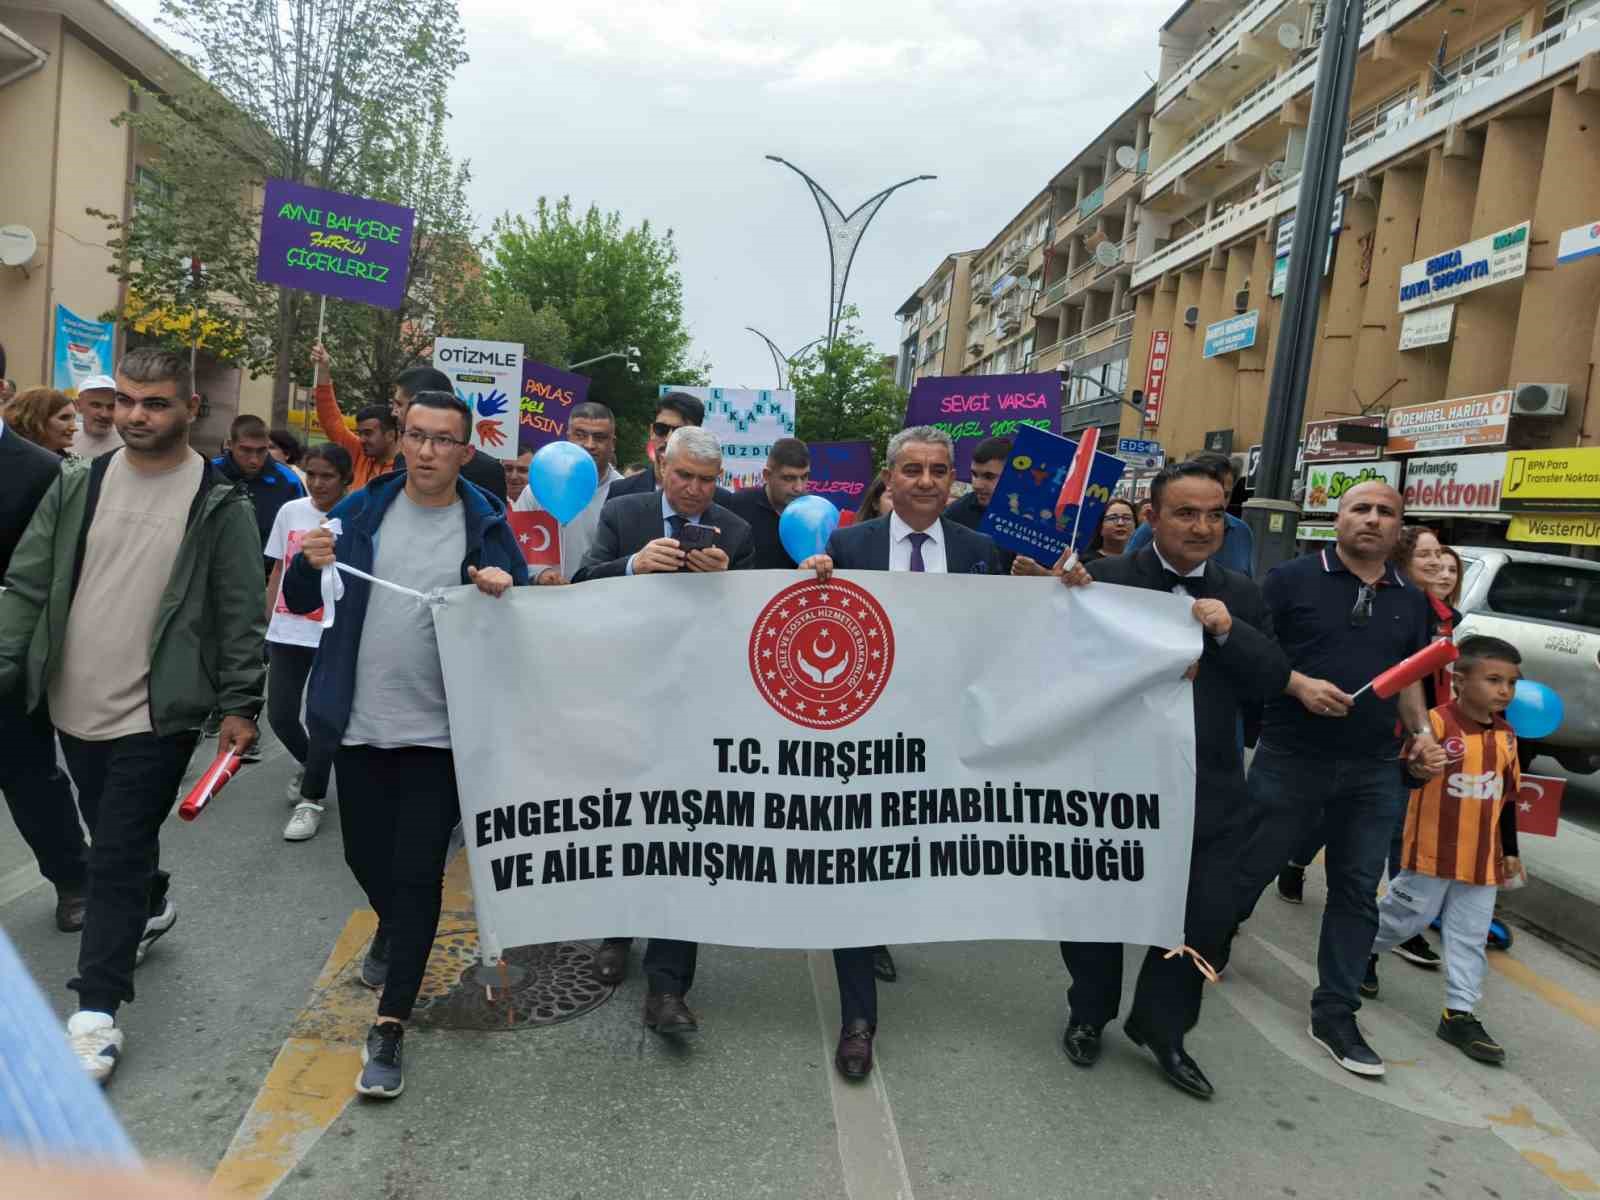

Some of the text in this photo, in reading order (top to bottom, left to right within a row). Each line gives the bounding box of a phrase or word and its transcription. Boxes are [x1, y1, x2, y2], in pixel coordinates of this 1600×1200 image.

[326, 212, 402, 244] BAHÇEDE
[286, 246, 390, 283] ÇİÇEKLERİZ
[439, 346, 518, 367] OTİZMLE
[525, 378, 576, 407] PAYLAŞ
[941, 392, 1047, 413] SEVGİ VARSA
[1401, 399, 1489, 425] DEMİREL HARİTA
[1120, 440, 1145, 452] EDS
[1527, 460, 1568, 470] BPN Para
[1527, 474, 1563, 483] Transfer
[713, 731, 926, 784] T.C. KIRŞEHİR
[475, 781, 1160, 848] ENGELSİZ YAŞAM BAKIM REHABİLİTASYON
[490, 833, 1145, 892] VE AİLE DANIŞMA MERKEZİ MÜDÜRLÜĞÜ
